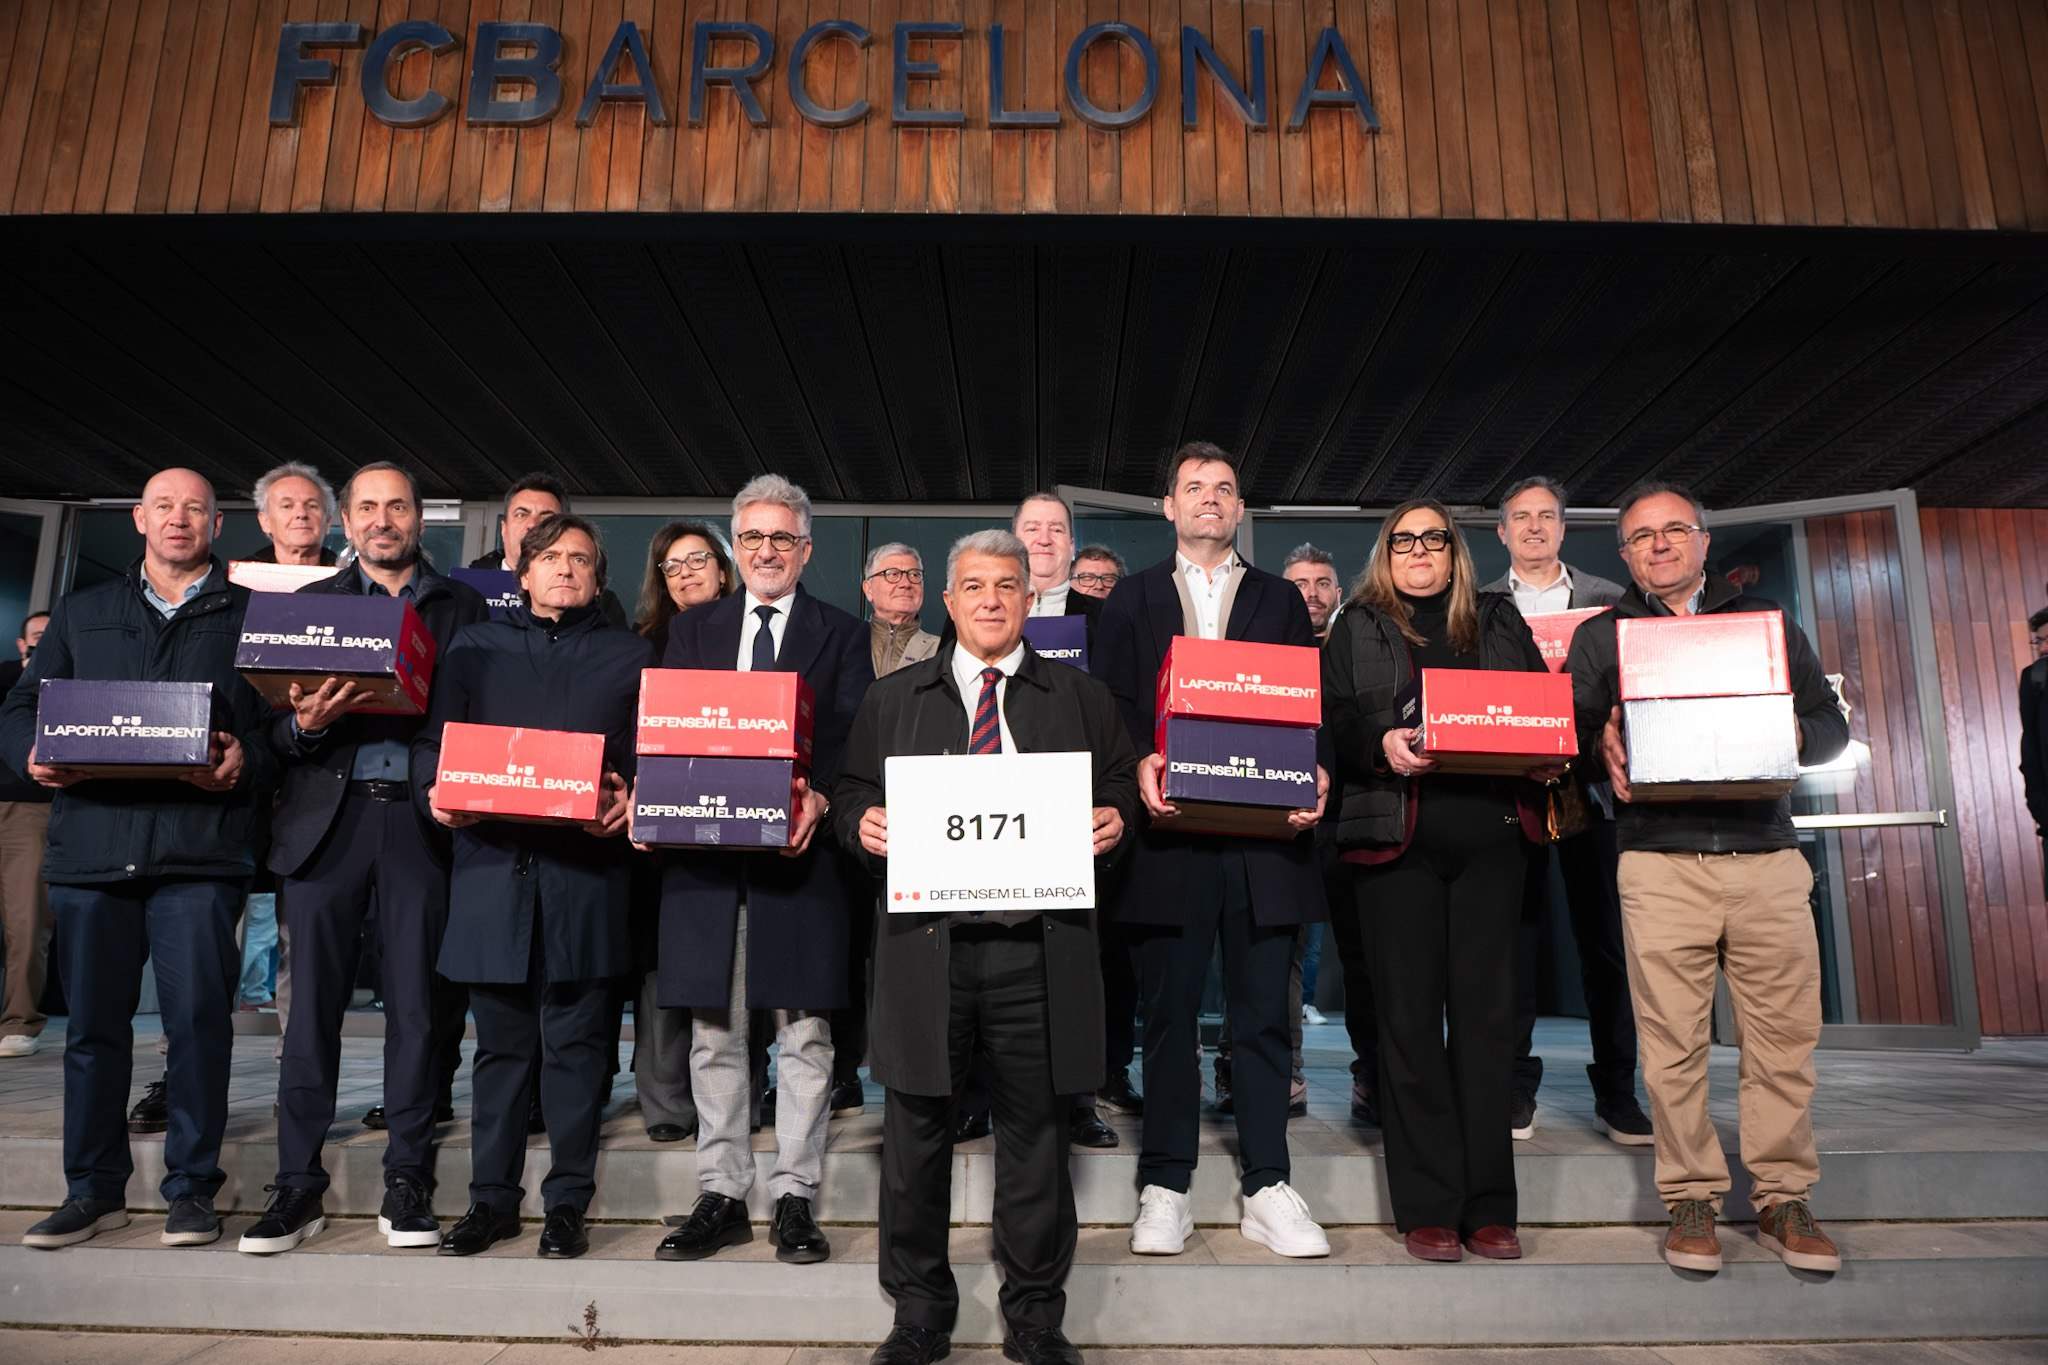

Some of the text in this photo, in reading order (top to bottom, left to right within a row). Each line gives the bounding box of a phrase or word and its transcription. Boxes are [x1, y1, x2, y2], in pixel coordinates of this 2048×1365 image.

[242, 633, 393, 651] DEFENSEM EL BARÇA
[1036, 649, 1082, 659] SIDENT
[1179, 678, 1243, 693] LAPORTA
[1244, 683, 1317, 699] PRESIDENT
[640, 715, 789, 733] DEFENSEM EL BARÇA
[1430, 713, 1570, 728] LAPORTA PRESIDENT
[44, 725, 206, 738] LAPORTA PRESIDENT
[1170, 761, 1315, 785] DEFENSEM EL BARÇA
[441, 770, 595, 795] DEFENSEM EL BARÇA
[637, 804, 787, 823] DEFENSEM EL BARÇA
[946, 813, 1026, 841] 8171
[929, 886, 1086, 901] DEFENSEM EL BARÇA
